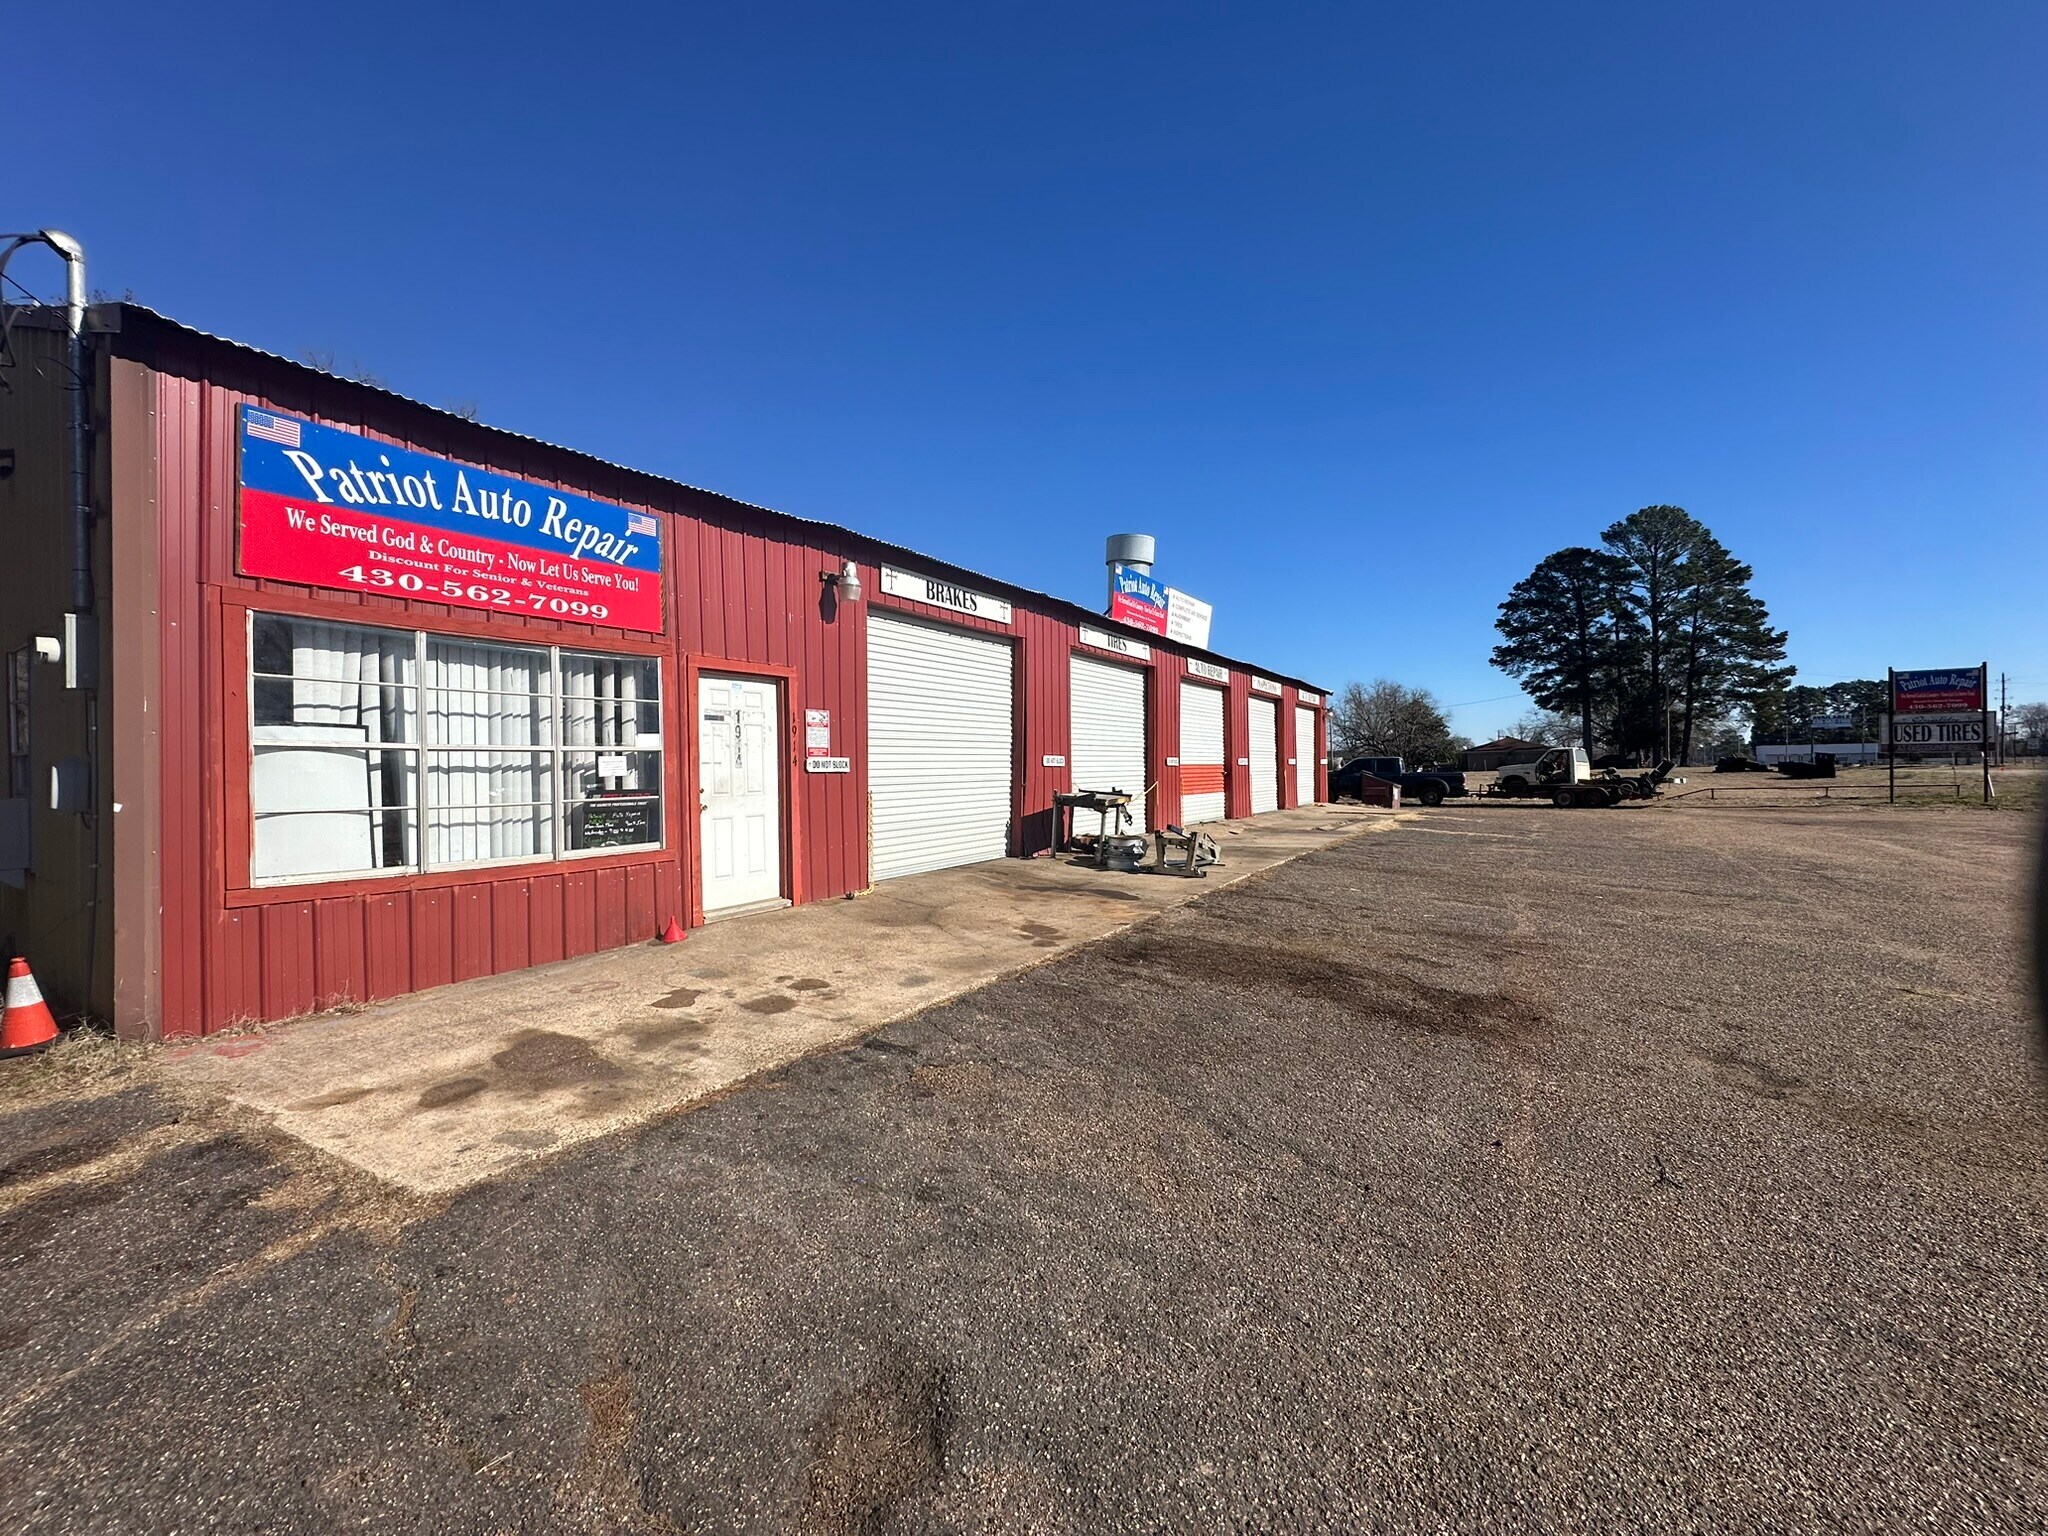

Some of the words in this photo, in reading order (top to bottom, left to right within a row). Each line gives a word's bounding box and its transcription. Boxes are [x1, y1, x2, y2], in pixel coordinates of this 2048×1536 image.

[282, 450, 443, 511] Patriot
[452, 470, 532, 528] Auto
[539, 496, 639, 566] Repair
[285, 507, 316, 531] We
[320, 514, 378, 544] Served
[382, 527, 415, 551] God
[420, 535, 434, 554] &
[438, 539, 495, 571] Country
[507, 552, 537, 573] Now
[539, 558, 560, 578] Let
[562, 563, 579, 581] Us
[581, 567, 612, 587] Serve
[614, 574, 639, 592] You!
[368, 550, 440, 571] Discount
[443, 563, 470, 576] For
[472, 569, 517, 584] Senior
[520, 577, 533, 587] &
[536, 580, 590, 597] Veterans
[338, 565, 609, 619] 430-562-7099
[926, 580, 977, 612] BRAKES
[1119, 574, 1138, 594] Patriot
[1138, 576, 1151, 597] Auto
[1150, 582, 1165, 610] Repair
[1107, 633, 1127, 652] TIRES
[1899, 676, 1928, 691] Patriot
[1928, 675, 1948, 686] Auto
[1948, 673, 1977, 690] Repair
[1894, 724, 1932, 743] USED
[1936, 723, 1981, 742] TIRES
[812, 760, 821, 769] DO
[821, 760, 831, 769] NOT
[832, 760, 848, 769] BLOCK
